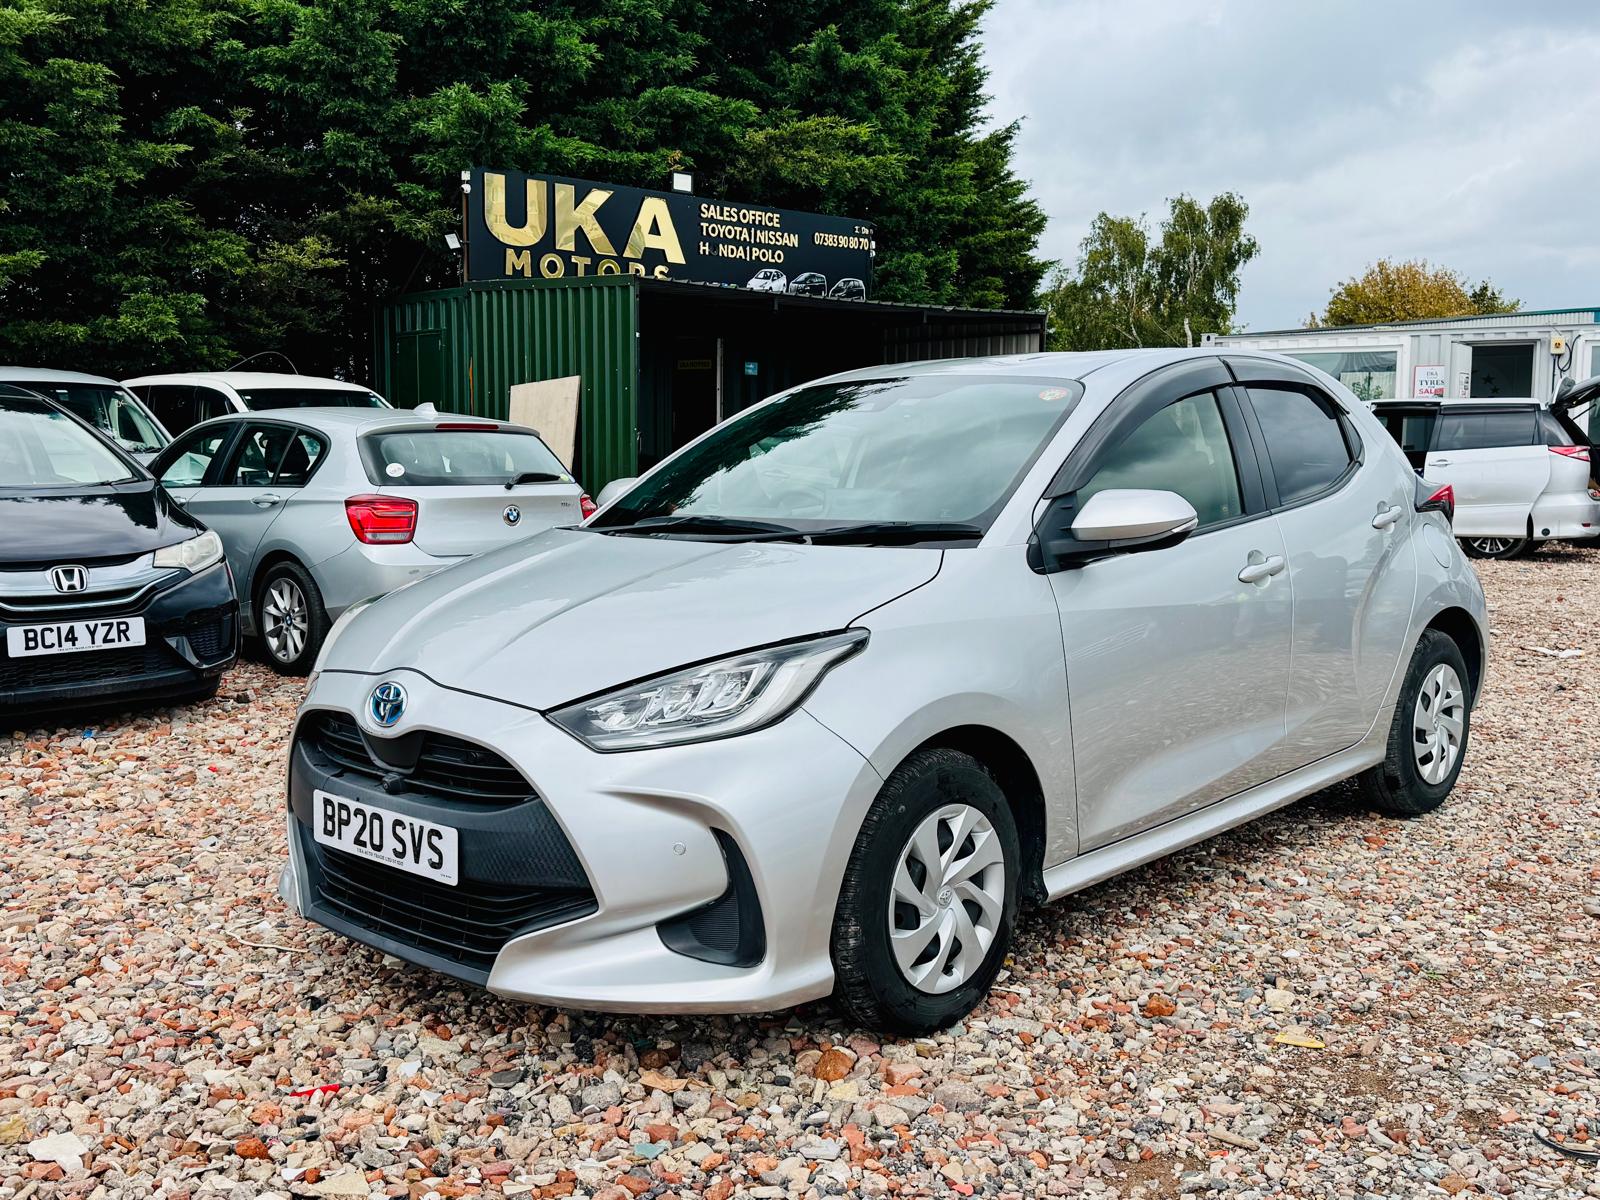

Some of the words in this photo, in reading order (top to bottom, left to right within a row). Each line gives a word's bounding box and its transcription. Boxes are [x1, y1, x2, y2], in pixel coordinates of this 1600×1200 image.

[484, 172, 686, 264] UKA
[700, 203, 738, 222] SALES
[739, 208, 781, 228] OFFICE
[23, 625, 79, 651] BC14
[85, 621, 131, 645] YZR
[322, 797, 384, 853] BP20
[391, 818, 444, 870] SVS
